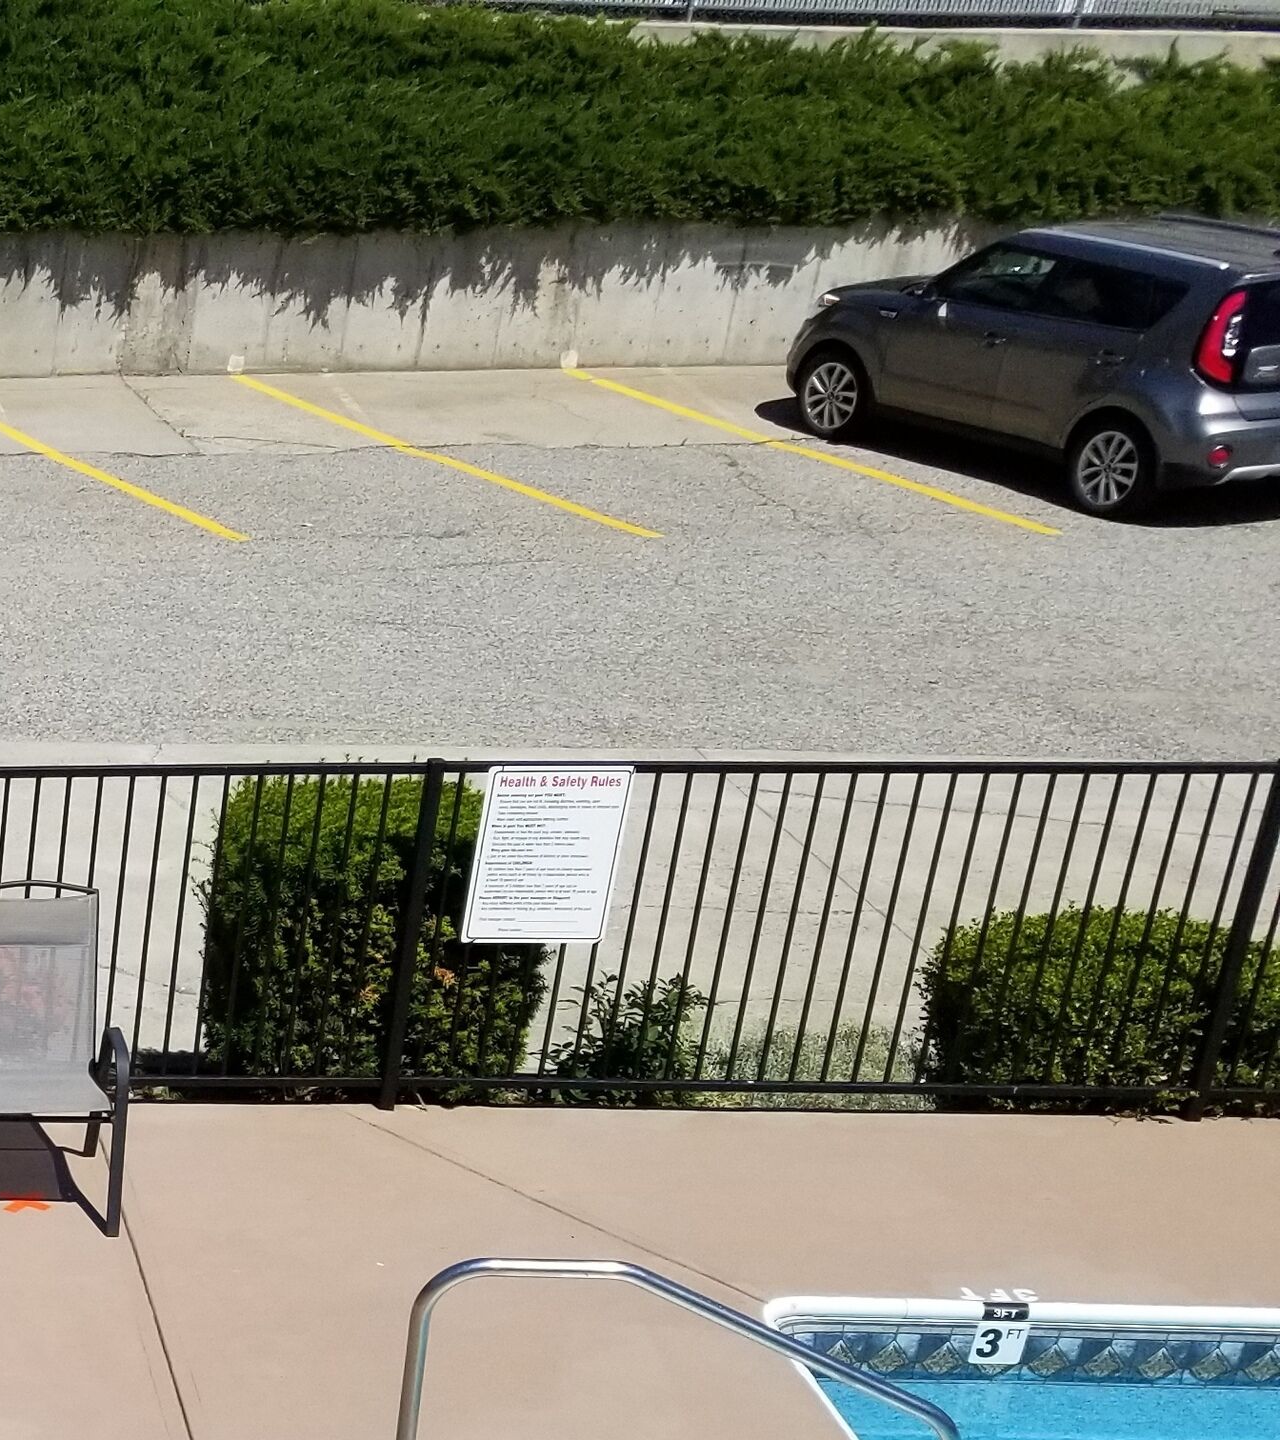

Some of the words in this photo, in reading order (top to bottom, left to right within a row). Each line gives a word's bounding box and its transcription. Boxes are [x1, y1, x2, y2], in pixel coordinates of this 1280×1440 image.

[500, 775, 536, 788] Health
[540, 775, 547, 787] &
[552, 775, 587, 790] Safety
[590, 775, 622, 787] Rules
[976, 1328, 1003, 1358] 3
[1006, 1328, 1025, 1340] FT
